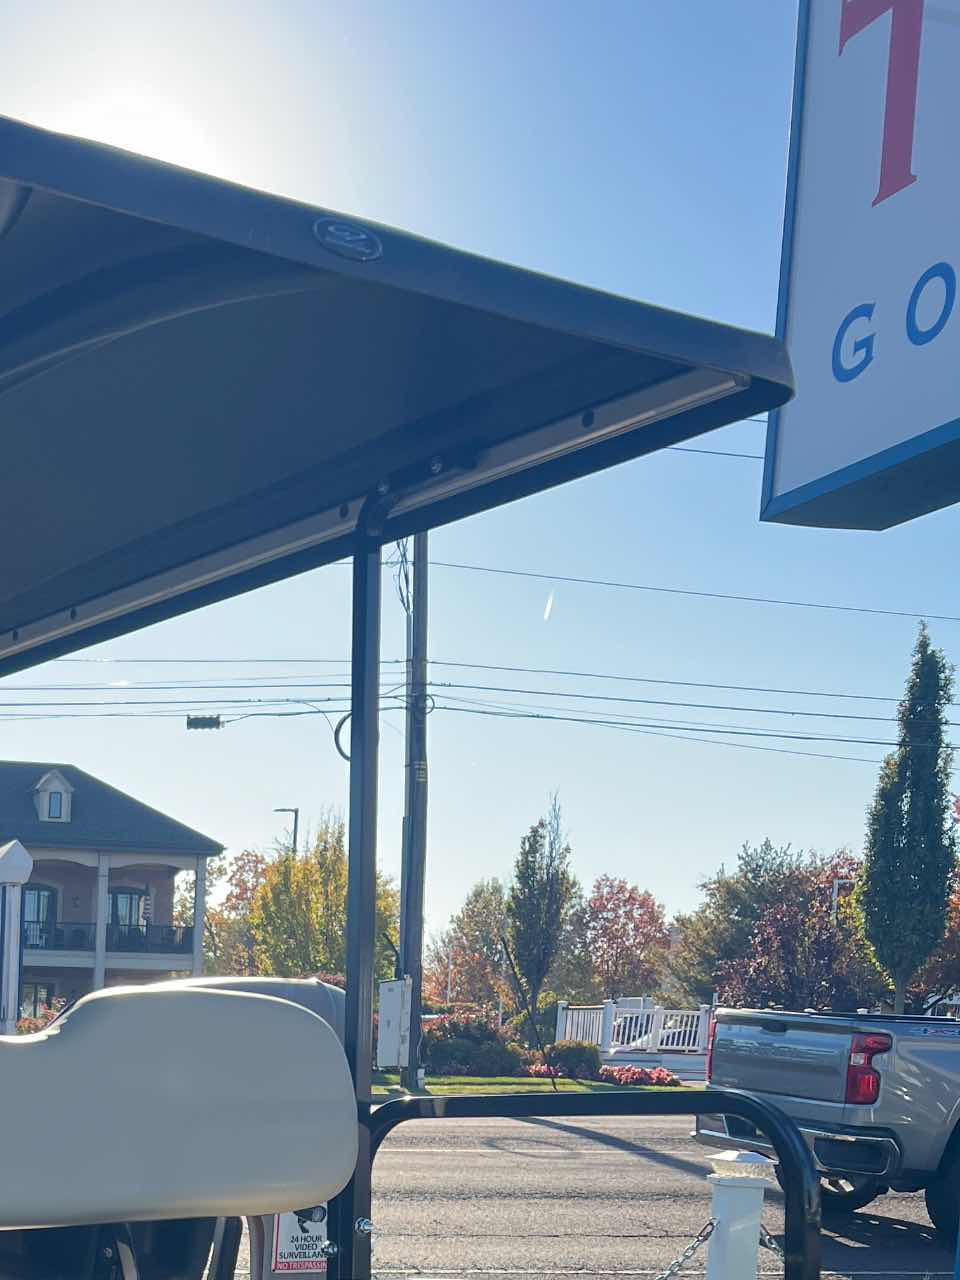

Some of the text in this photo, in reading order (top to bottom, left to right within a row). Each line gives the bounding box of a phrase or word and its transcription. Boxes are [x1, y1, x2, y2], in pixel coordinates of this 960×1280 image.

[290, 1235, 322, 1243] 24 HOUR
[294, 1243, 318, 1251] VIDEO
[279, 1251, 328, 1259] SURVEILLAN
[277, 1261, 327, 1270] NO TRESPASSIN
